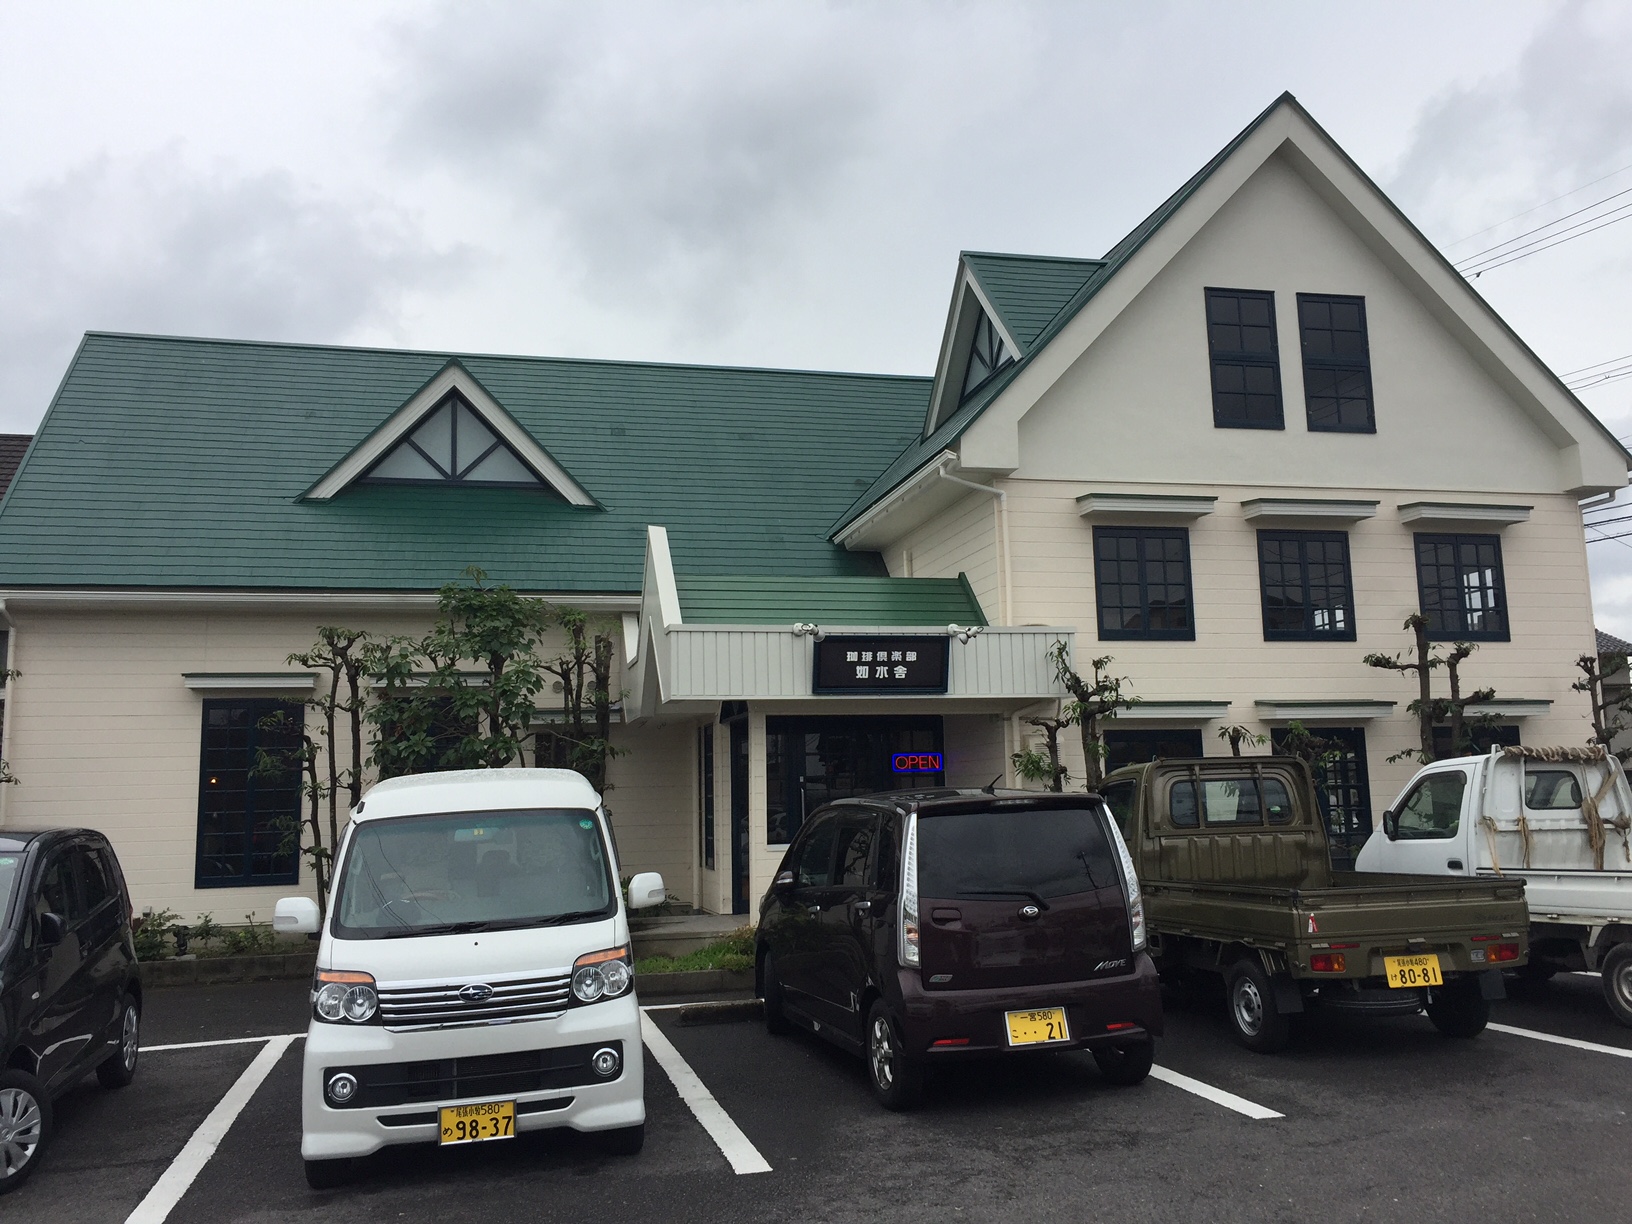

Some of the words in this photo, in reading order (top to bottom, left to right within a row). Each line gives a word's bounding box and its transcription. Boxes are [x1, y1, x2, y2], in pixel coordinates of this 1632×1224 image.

[846, 651, 917, 662] 珈琲倶楽部
[895, 755, 940, 770] OPEN
[1093, 958, 1127, 971] MOVE
[1398, 966, 1438, 985] 80-81
[442, 1127, 453, 1138] め
[455, 1115, 513, 1140] 98-37
